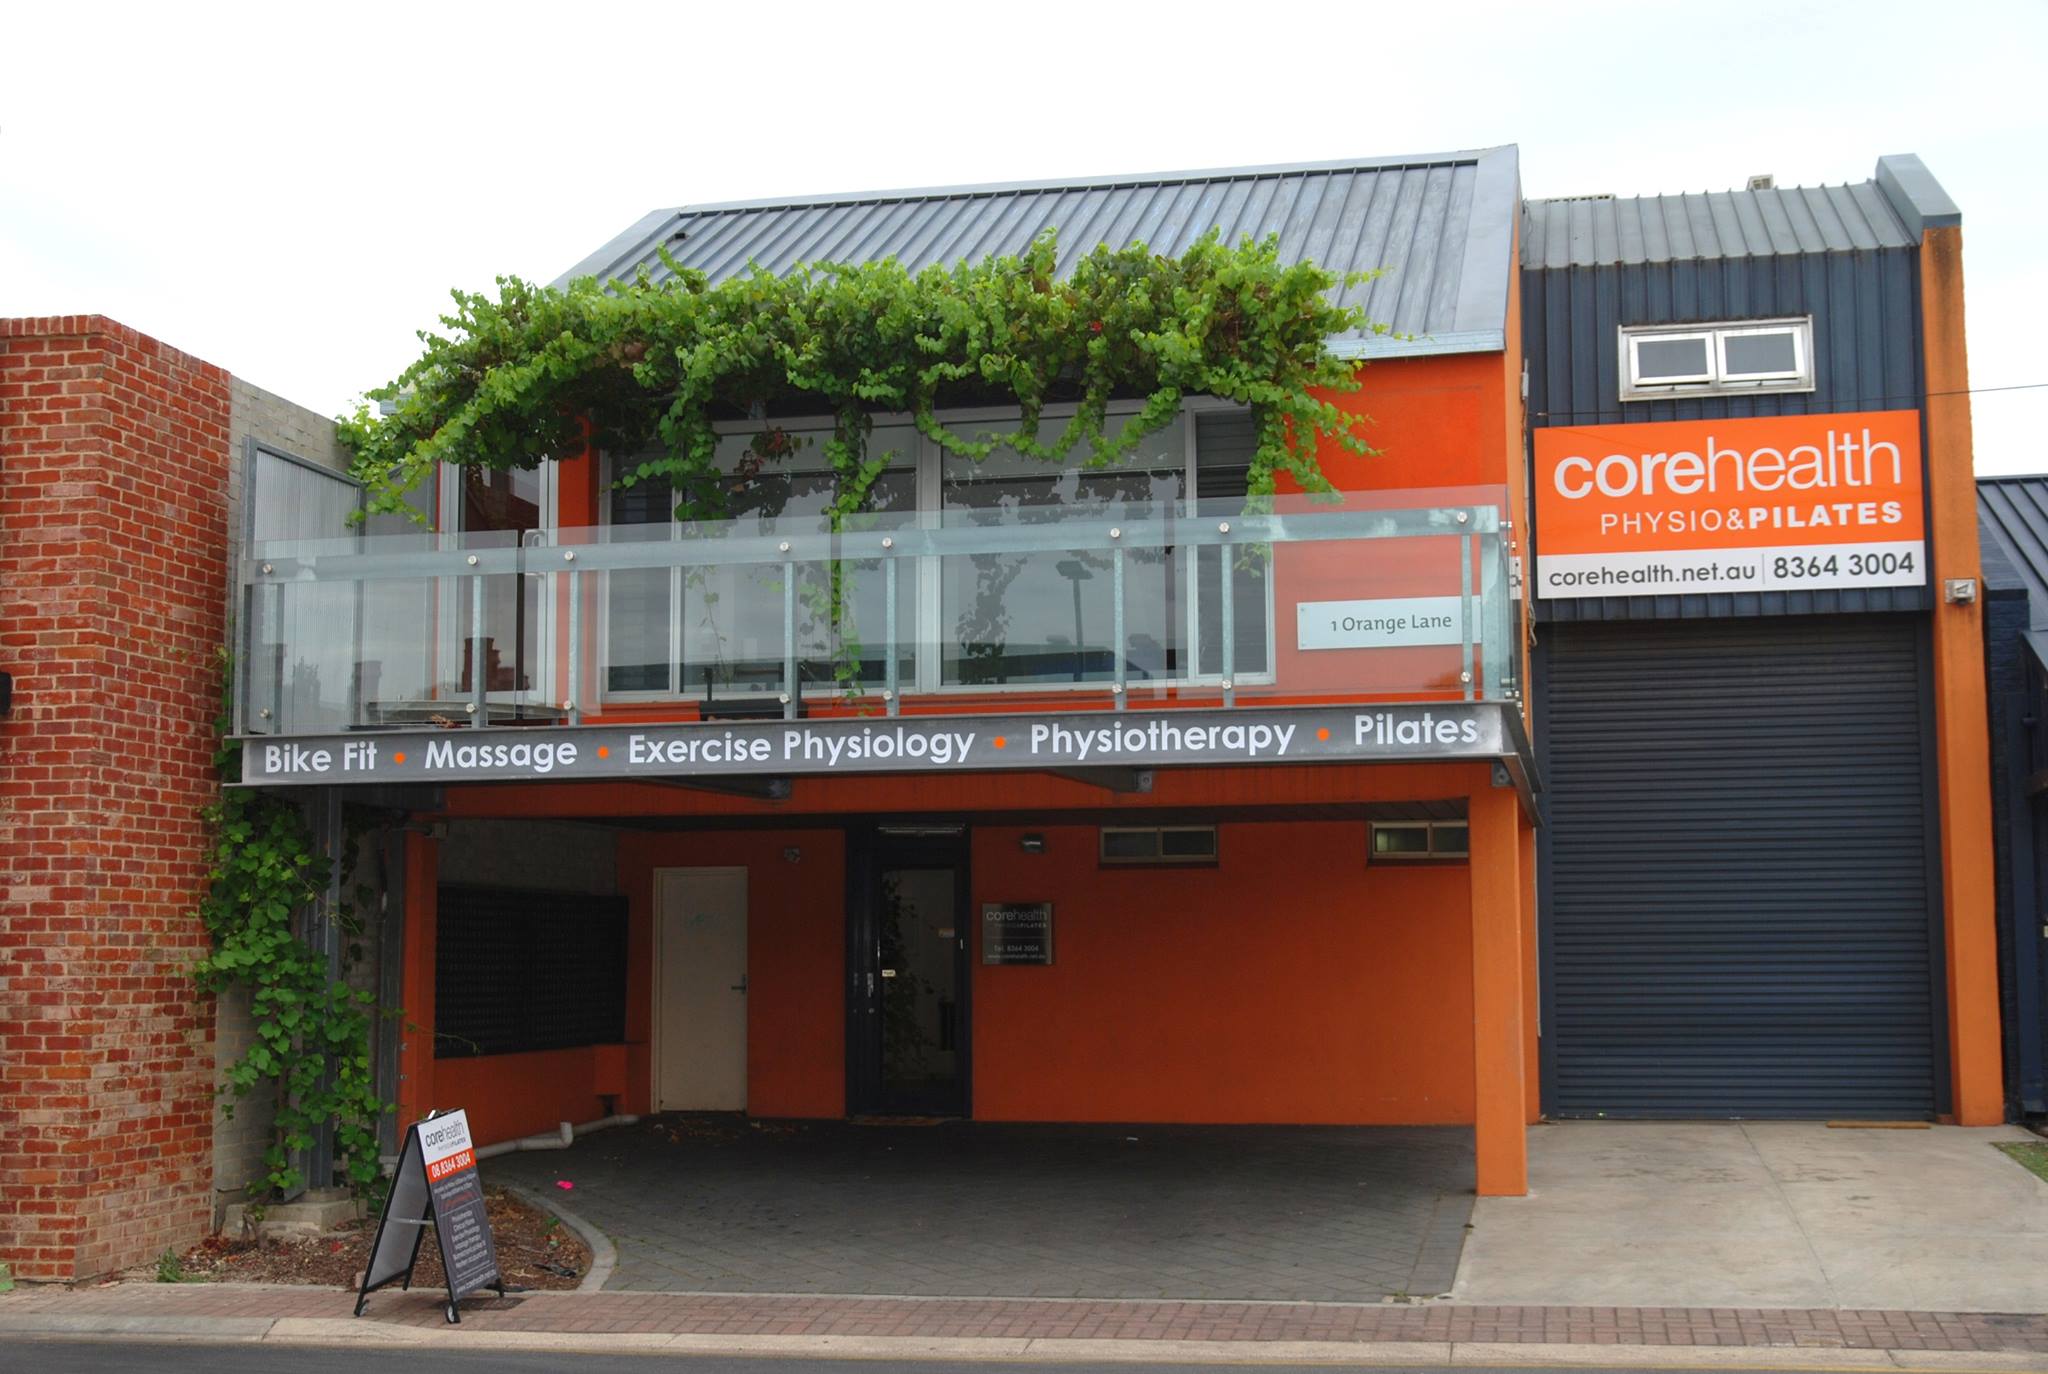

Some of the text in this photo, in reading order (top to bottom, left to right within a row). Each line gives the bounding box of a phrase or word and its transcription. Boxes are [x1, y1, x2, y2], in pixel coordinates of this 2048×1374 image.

[1553, 428, 1902, 499] corehealth
[1601, 501, 1903, 535] PHYSIO&PILATES
[1549, 562, 1755, 586] corehealth.net.au
[1773, 555, 1839, 579] 8364
[1848, 552, 1914, 577] 3004
[1331, 614, 1452, 634] 1 Orange Lane
[265, 712, 1477, 773] Bike Fit Massage Exercise Physiology Physiotherapy Pilates
[986, 908, 1048, 921] corehealth
[425, 1120, 465, 1147] corehealth
[431, 1162, 441, 1178] 08
[457, 1151, 471, 1169] 3004
